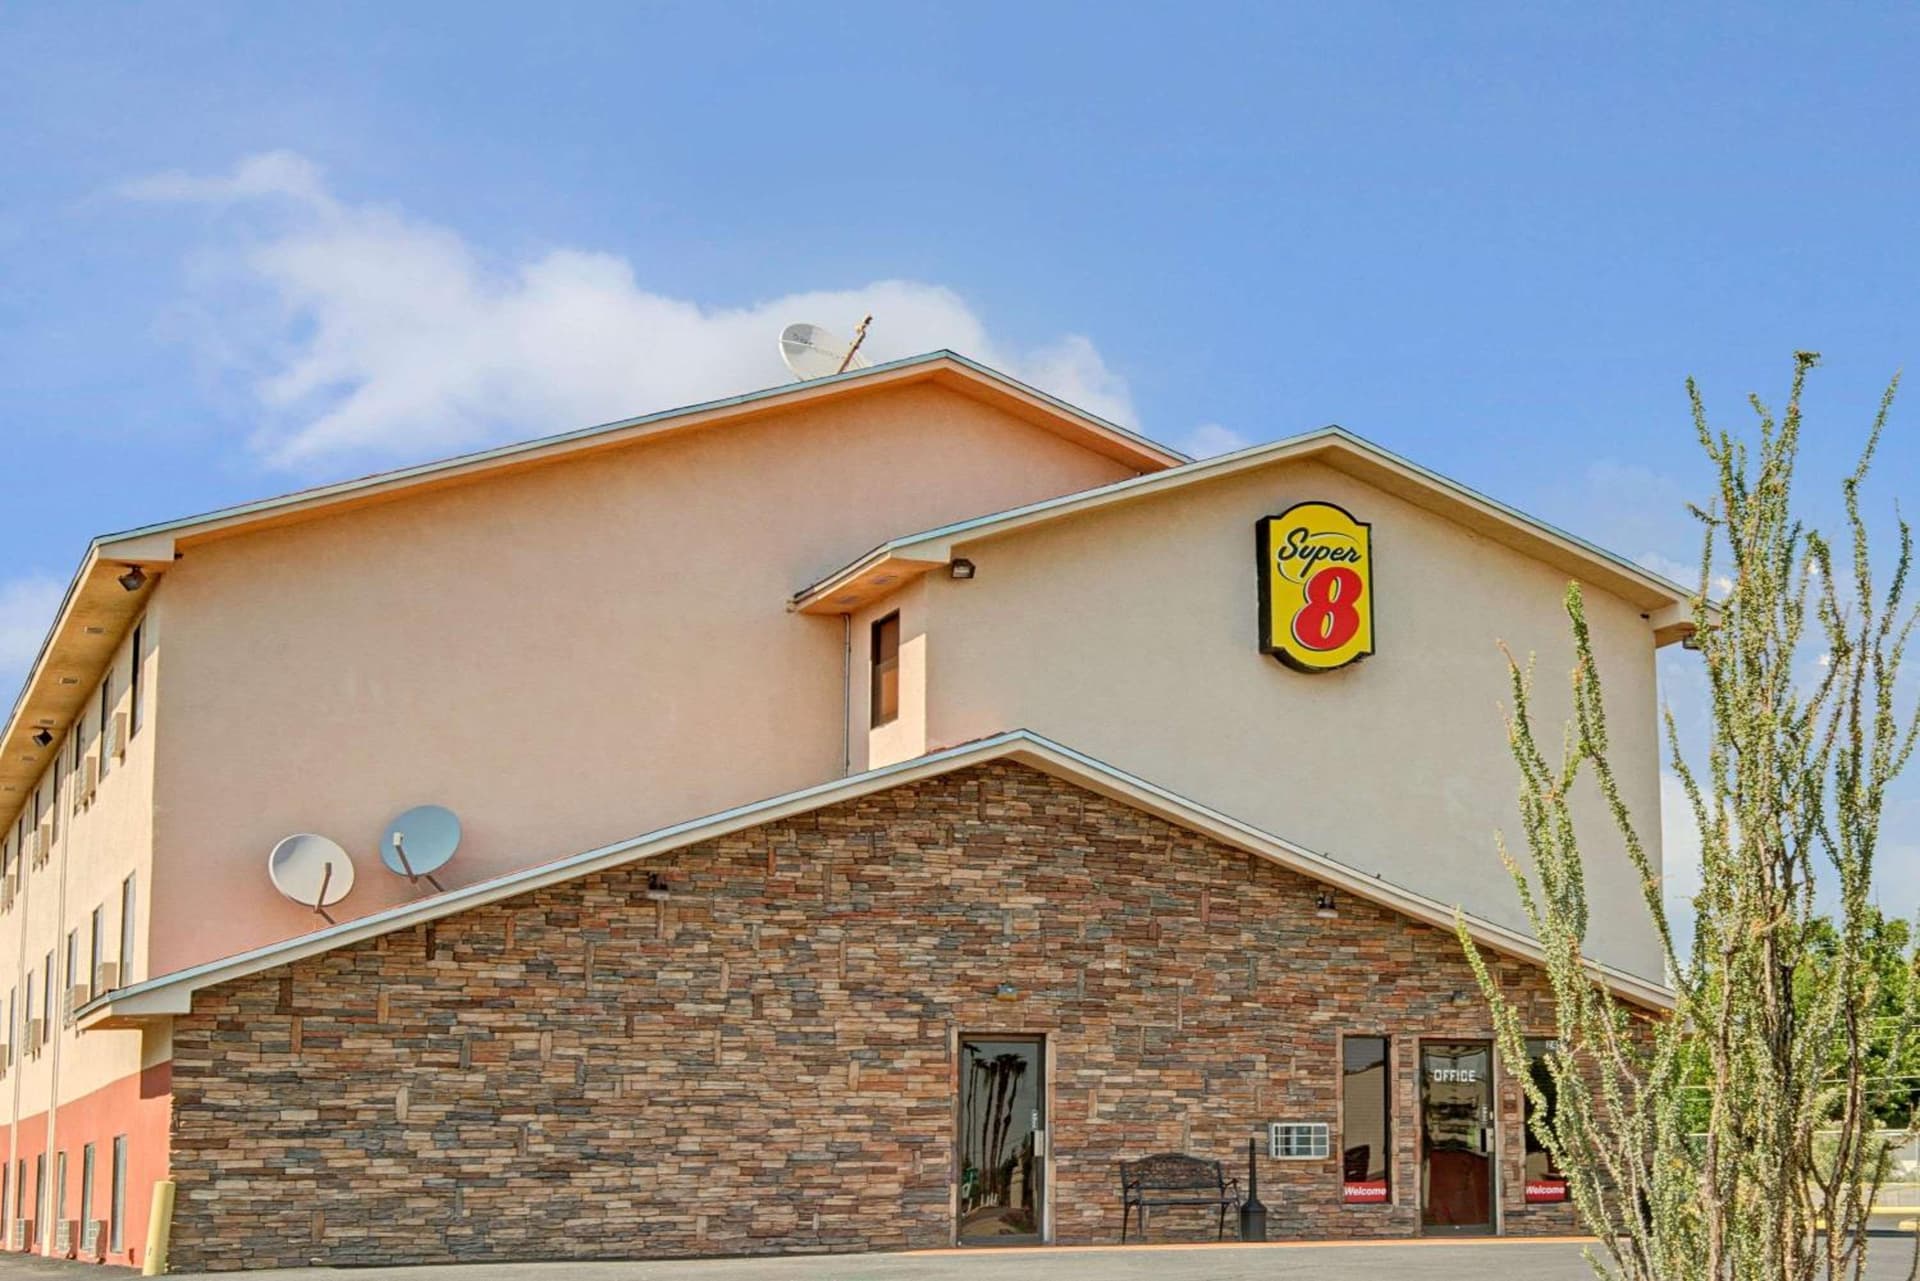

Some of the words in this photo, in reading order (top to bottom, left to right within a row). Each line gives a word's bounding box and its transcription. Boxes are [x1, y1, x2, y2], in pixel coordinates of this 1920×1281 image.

[1278, 527, 1362, 578] Super
[1291, 566, 1363, 651] 8
[1434, 1069, 1476, 1082] OFFICE
[1344, 1186, 1386, 1196] Welcome
[1526, 1185, 1565, 1194] Welcome
